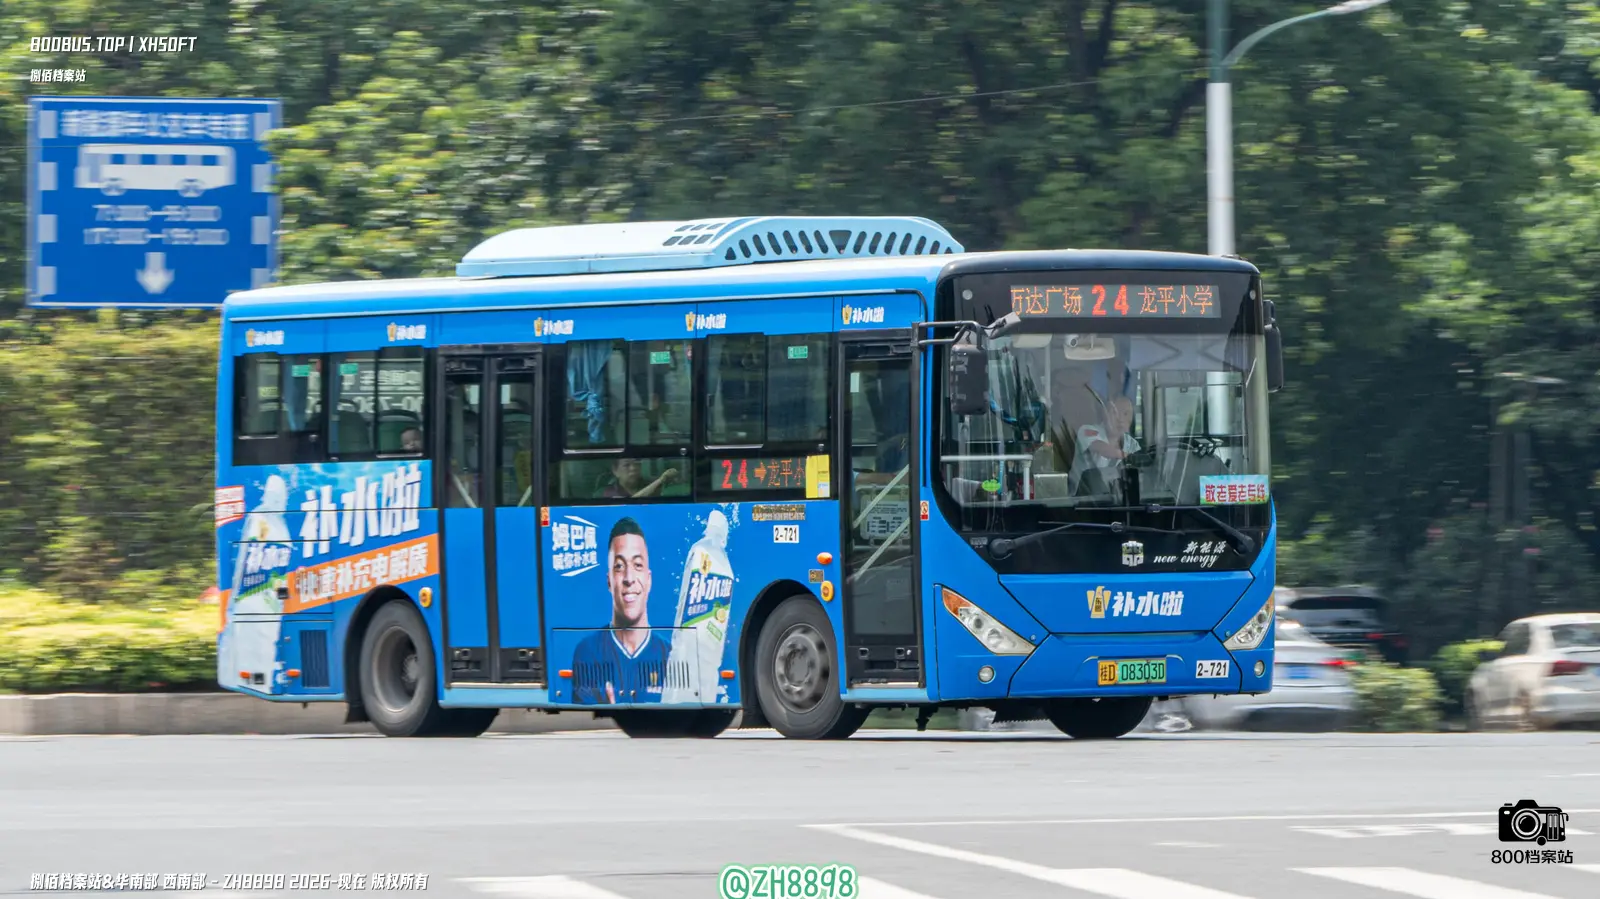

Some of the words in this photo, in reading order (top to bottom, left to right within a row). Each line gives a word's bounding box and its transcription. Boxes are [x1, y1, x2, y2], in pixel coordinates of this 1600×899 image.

[1091, 284, 1130, 316] 24
[1137, 285, 1214, 315] 龙平小学
[852, 306, 886, 324] 补水啦
[721, 459, 749, 489] 24
[299, 463, 422, 559] 补水啦
[552, 521, 598, 552] 姆巴佩
[774, 526, 798, 542] 2-721
[1182, 540, 1227, 555] 新能源
[1153, 554, 1179, 564] new
[1180, 554, 1220, 569] energy
[688, 572, 733, 605] 补水啦
[1112, 590, 1185, 618] 补水啦
[1197, 661, 1228, 677] 2-721
